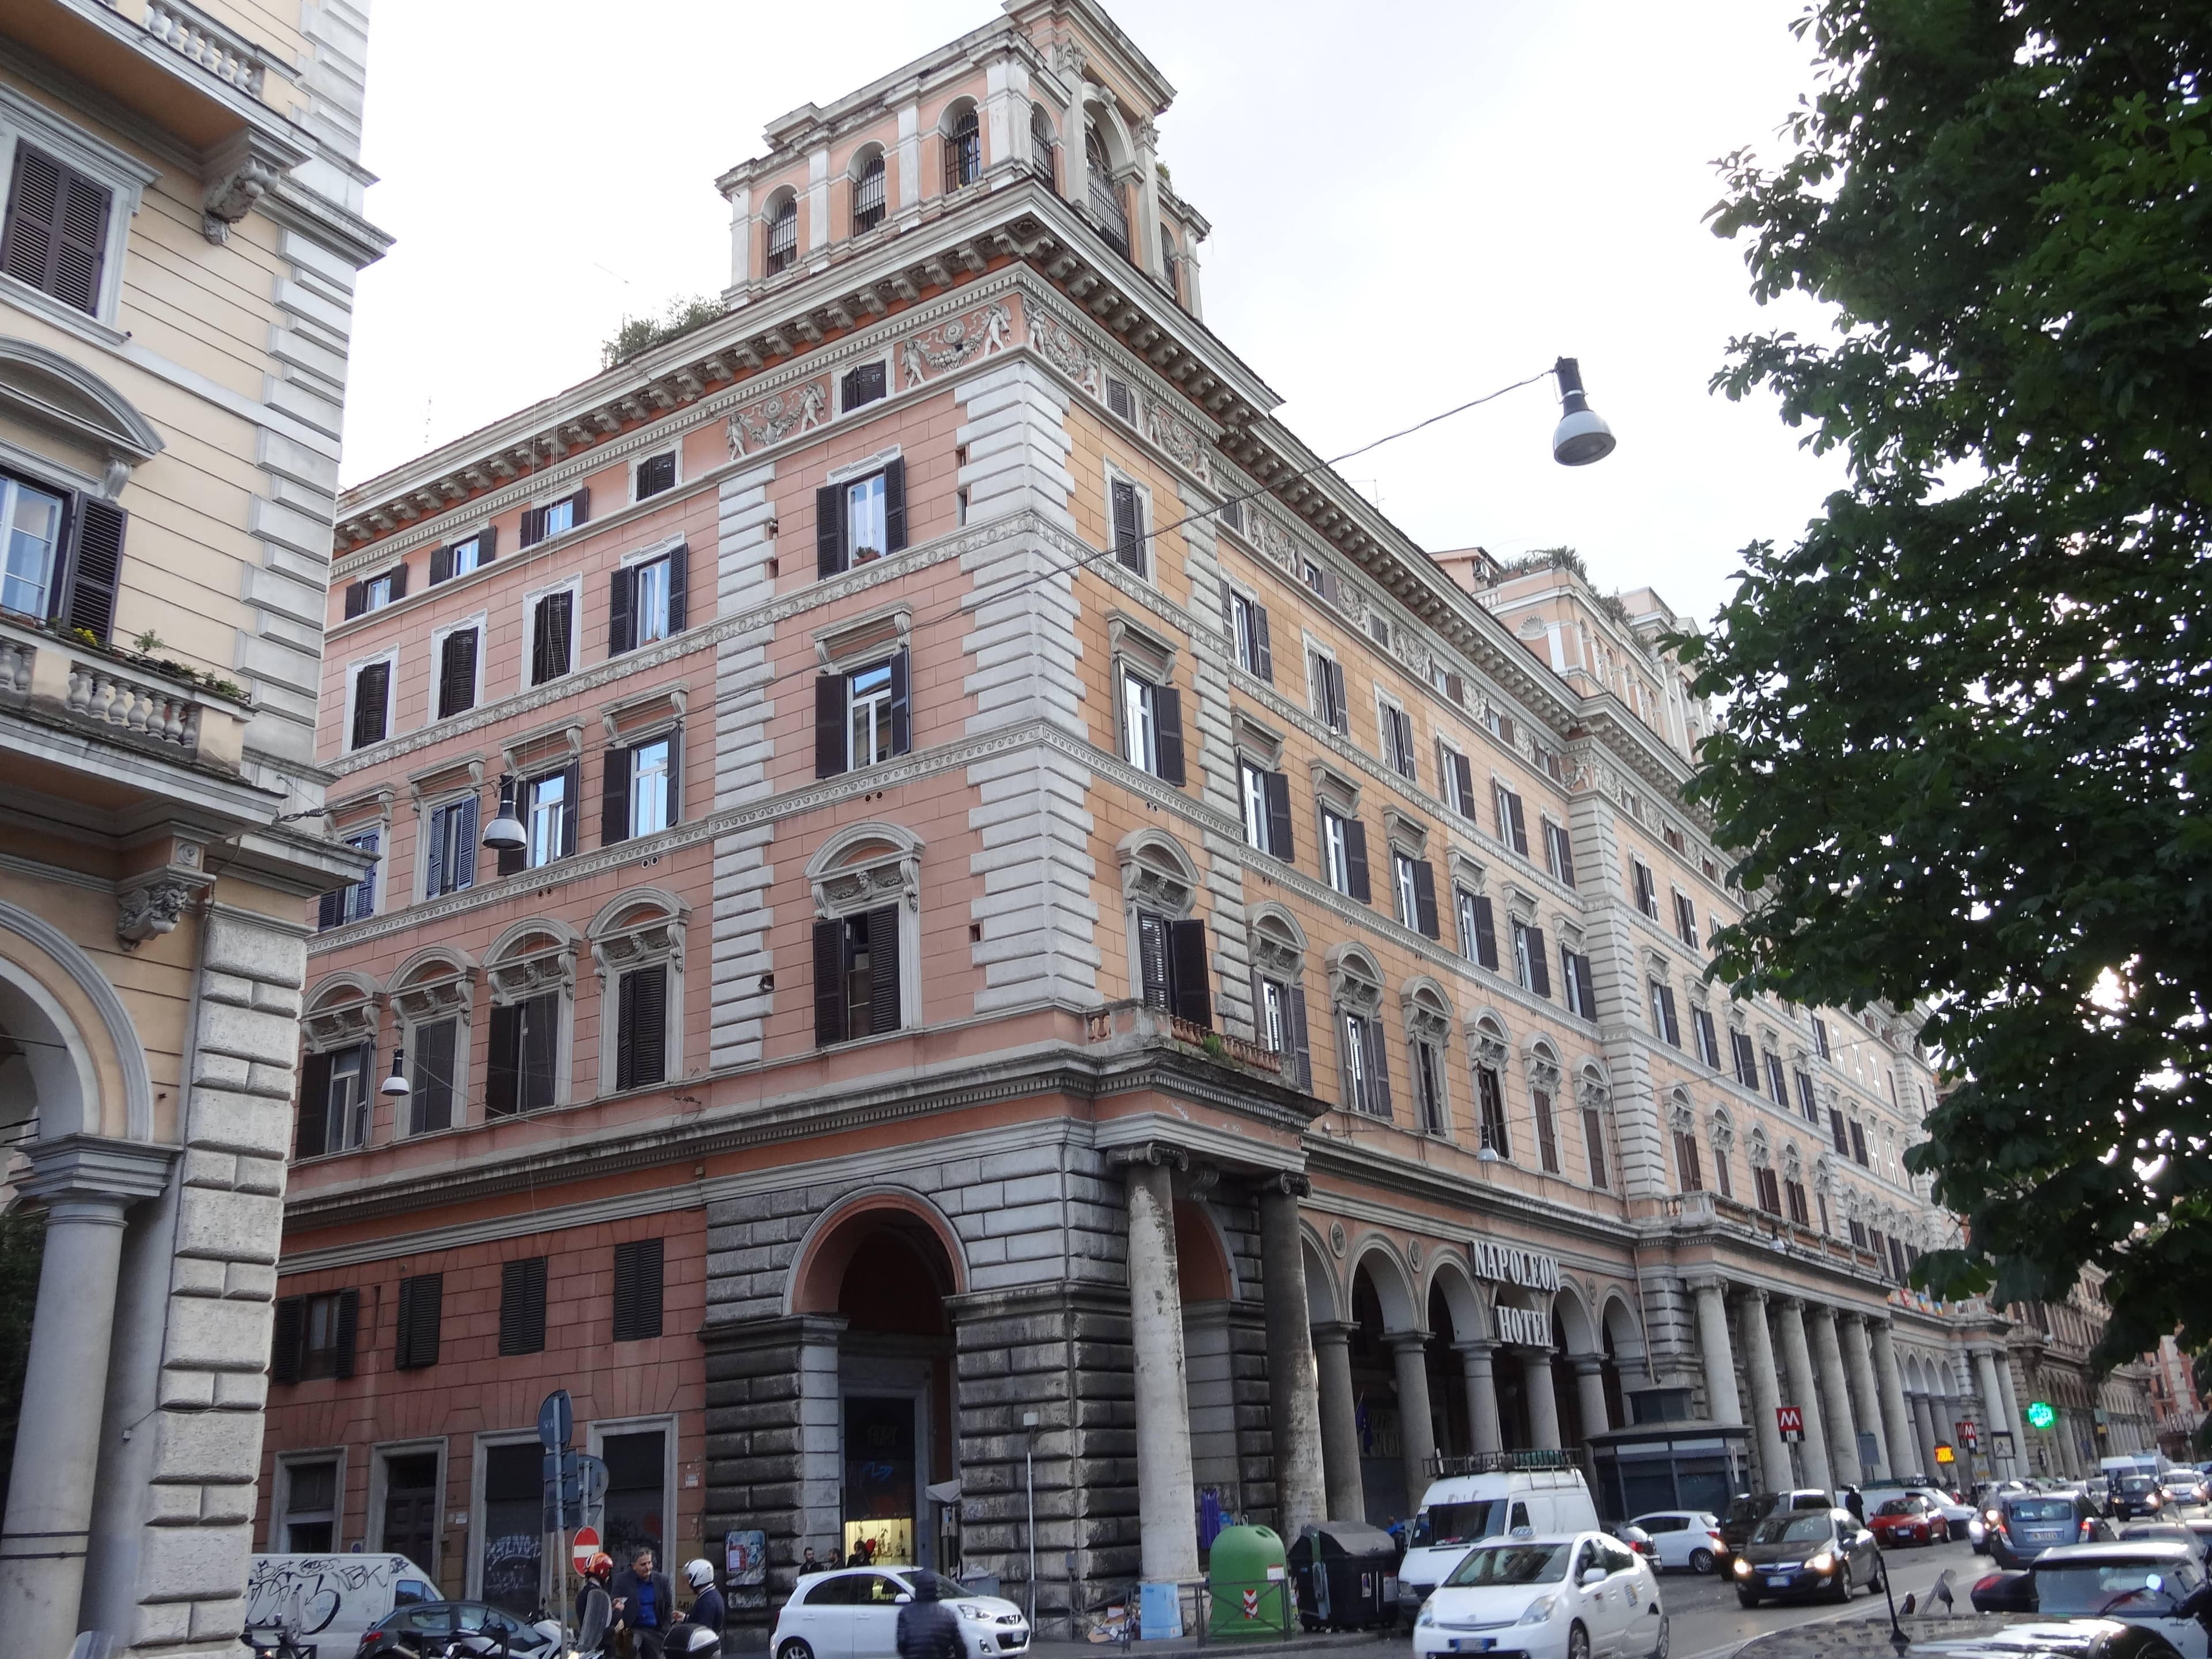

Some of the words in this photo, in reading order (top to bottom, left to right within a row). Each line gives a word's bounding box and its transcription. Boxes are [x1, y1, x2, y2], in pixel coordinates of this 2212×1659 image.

[1474, 1240, 1560, 1292] NAPOLEON
[1496, 1305, 1553, 1347] HOTEL
[1781, 1410, 1800, 1427] M
[1965, 1424, 1975, 1437] M
